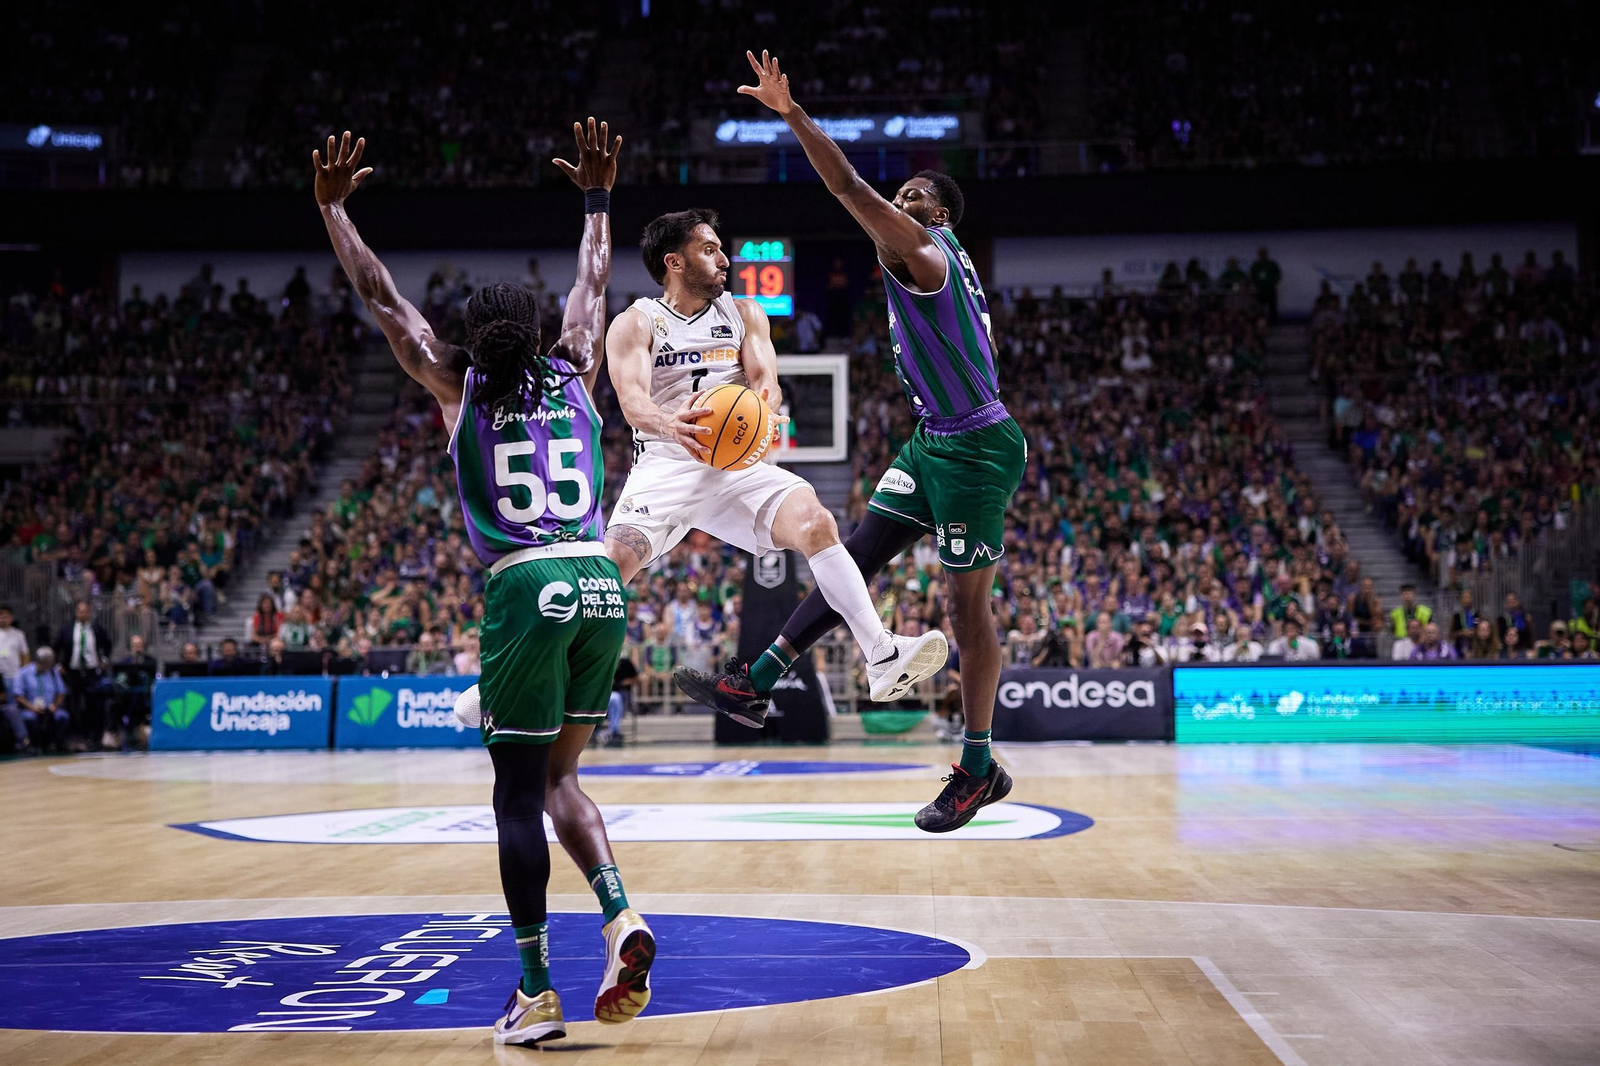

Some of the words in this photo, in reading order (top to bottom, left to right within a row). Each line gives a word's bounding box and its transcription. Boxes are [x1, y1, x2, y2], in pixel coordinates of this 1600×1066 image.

[739, 265, 784, 298] 19
[654, 348, 740, 368] AUTOHER
[691, 368, 708, 393] 7
[733, 422, 749, 445] acb
[494, 438, 592, 524] 55
[578, 577, 621, 592] COSTA
[582, 593, 605, 605] DEL
[605, 593, 625, 606] SOL
[583, 605, 625, 619] MÁLAGA
[211, 690, 323, 713] Fundación
[998, 673, 1155, 709] endesa
[210, 711, 291, 736] Unicaja
